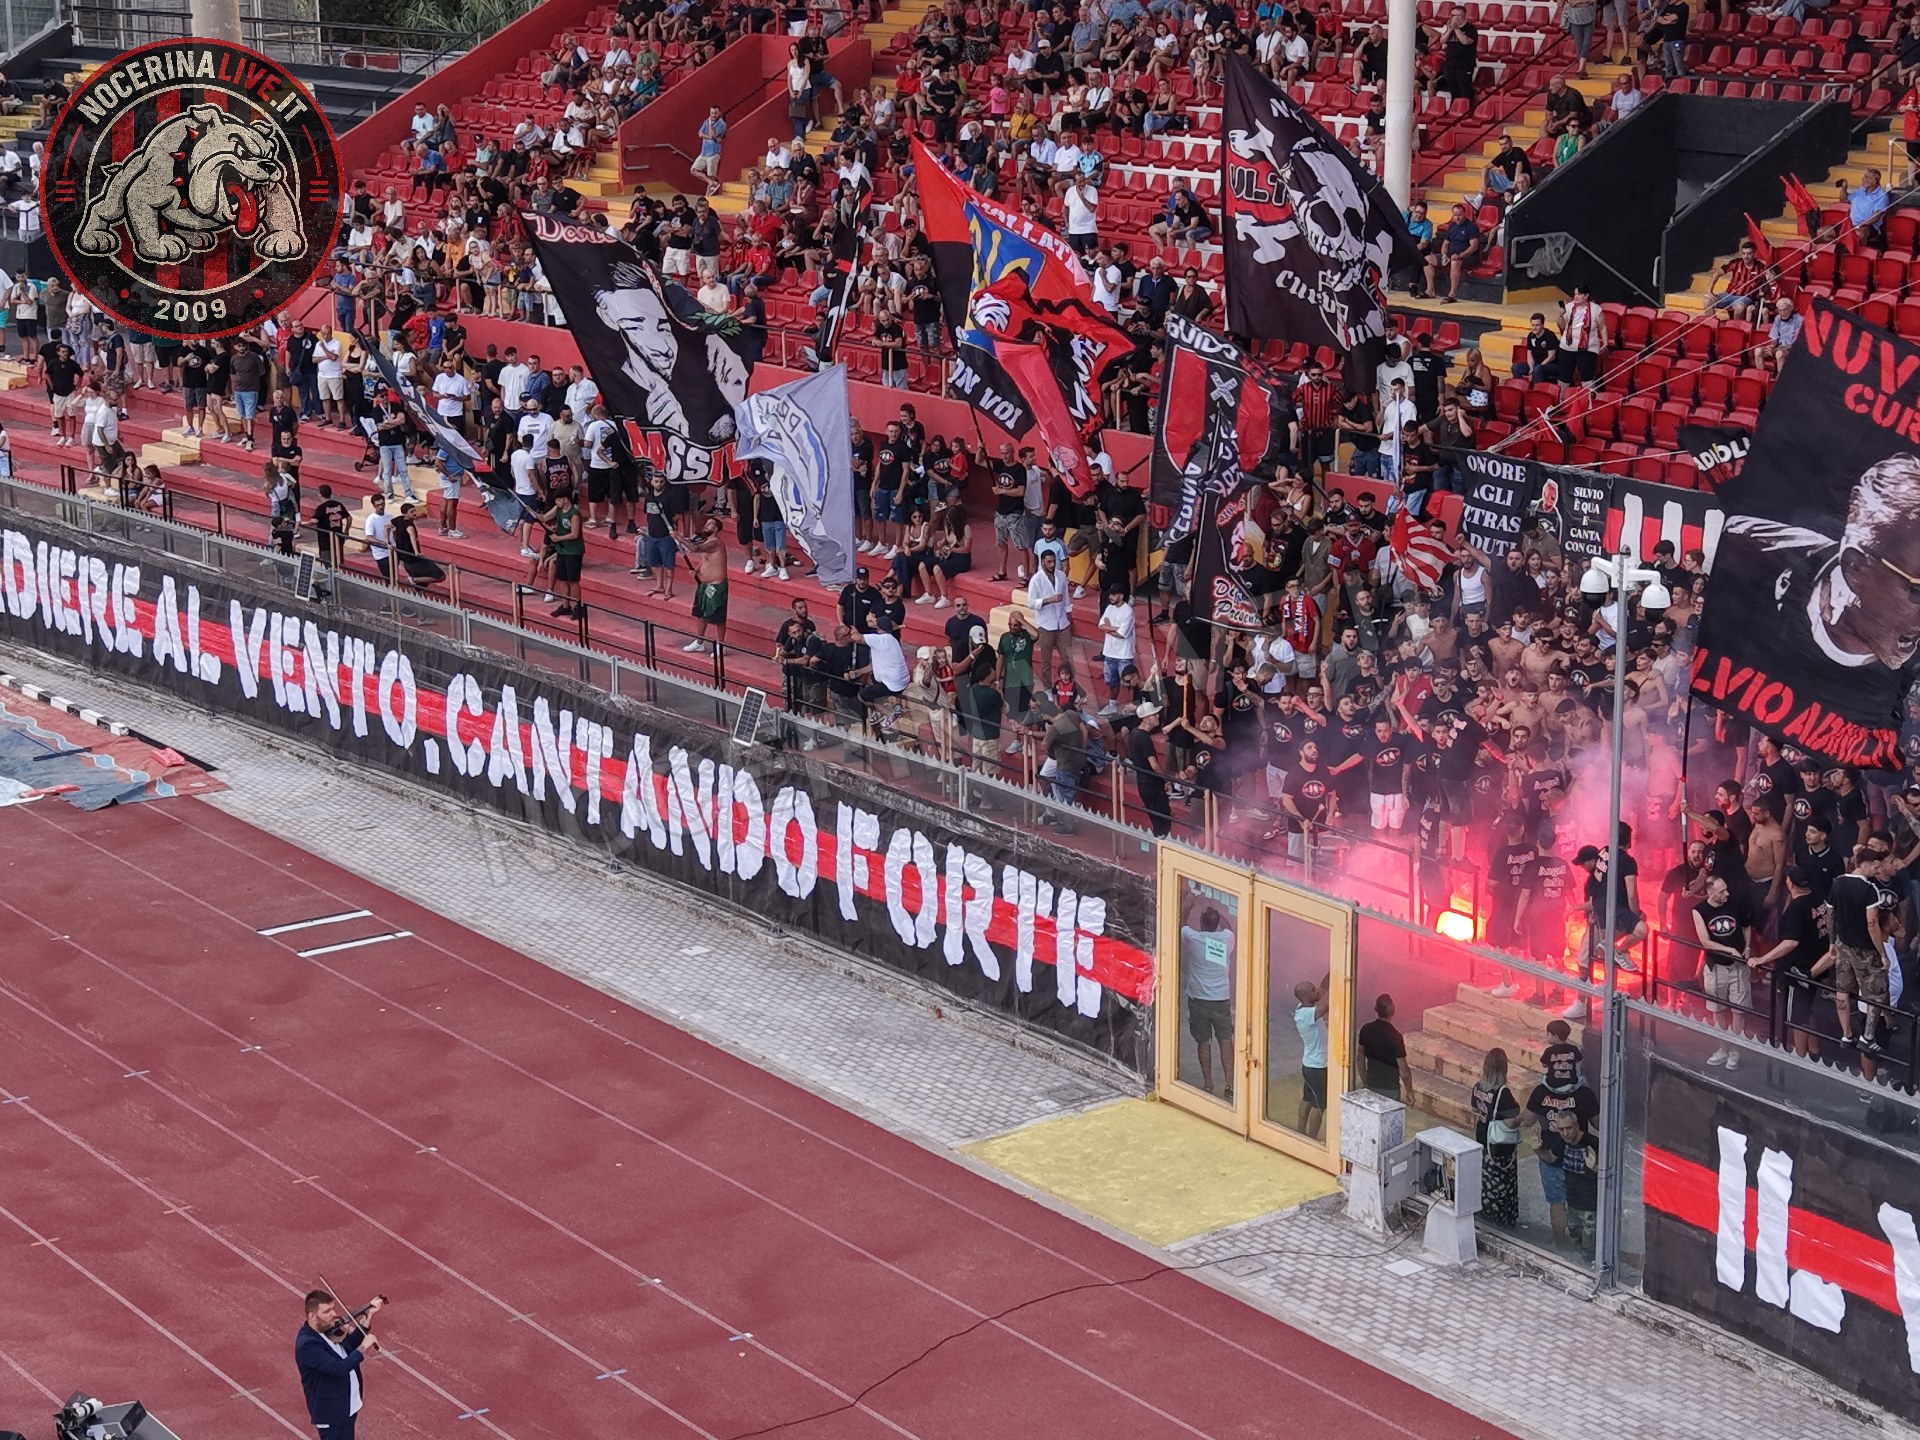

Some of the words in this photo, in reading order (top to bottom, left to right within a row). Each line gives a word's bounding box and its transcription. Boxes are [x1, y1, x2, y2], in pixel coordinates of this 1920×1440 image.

[979, 386, 1024, 430] VOI
[1466, 454, 1527, 483] ONORE
[1573, 486, 1604, 500] SILVIO
[1569, 527, 1601, 542] CANTA
[1564, 539, 1586, 553] CON
[0, 529, 143, 658] DIERE
[153, 574, 222, 686] AL
[836, 800, 1107, 1019] FORTE
